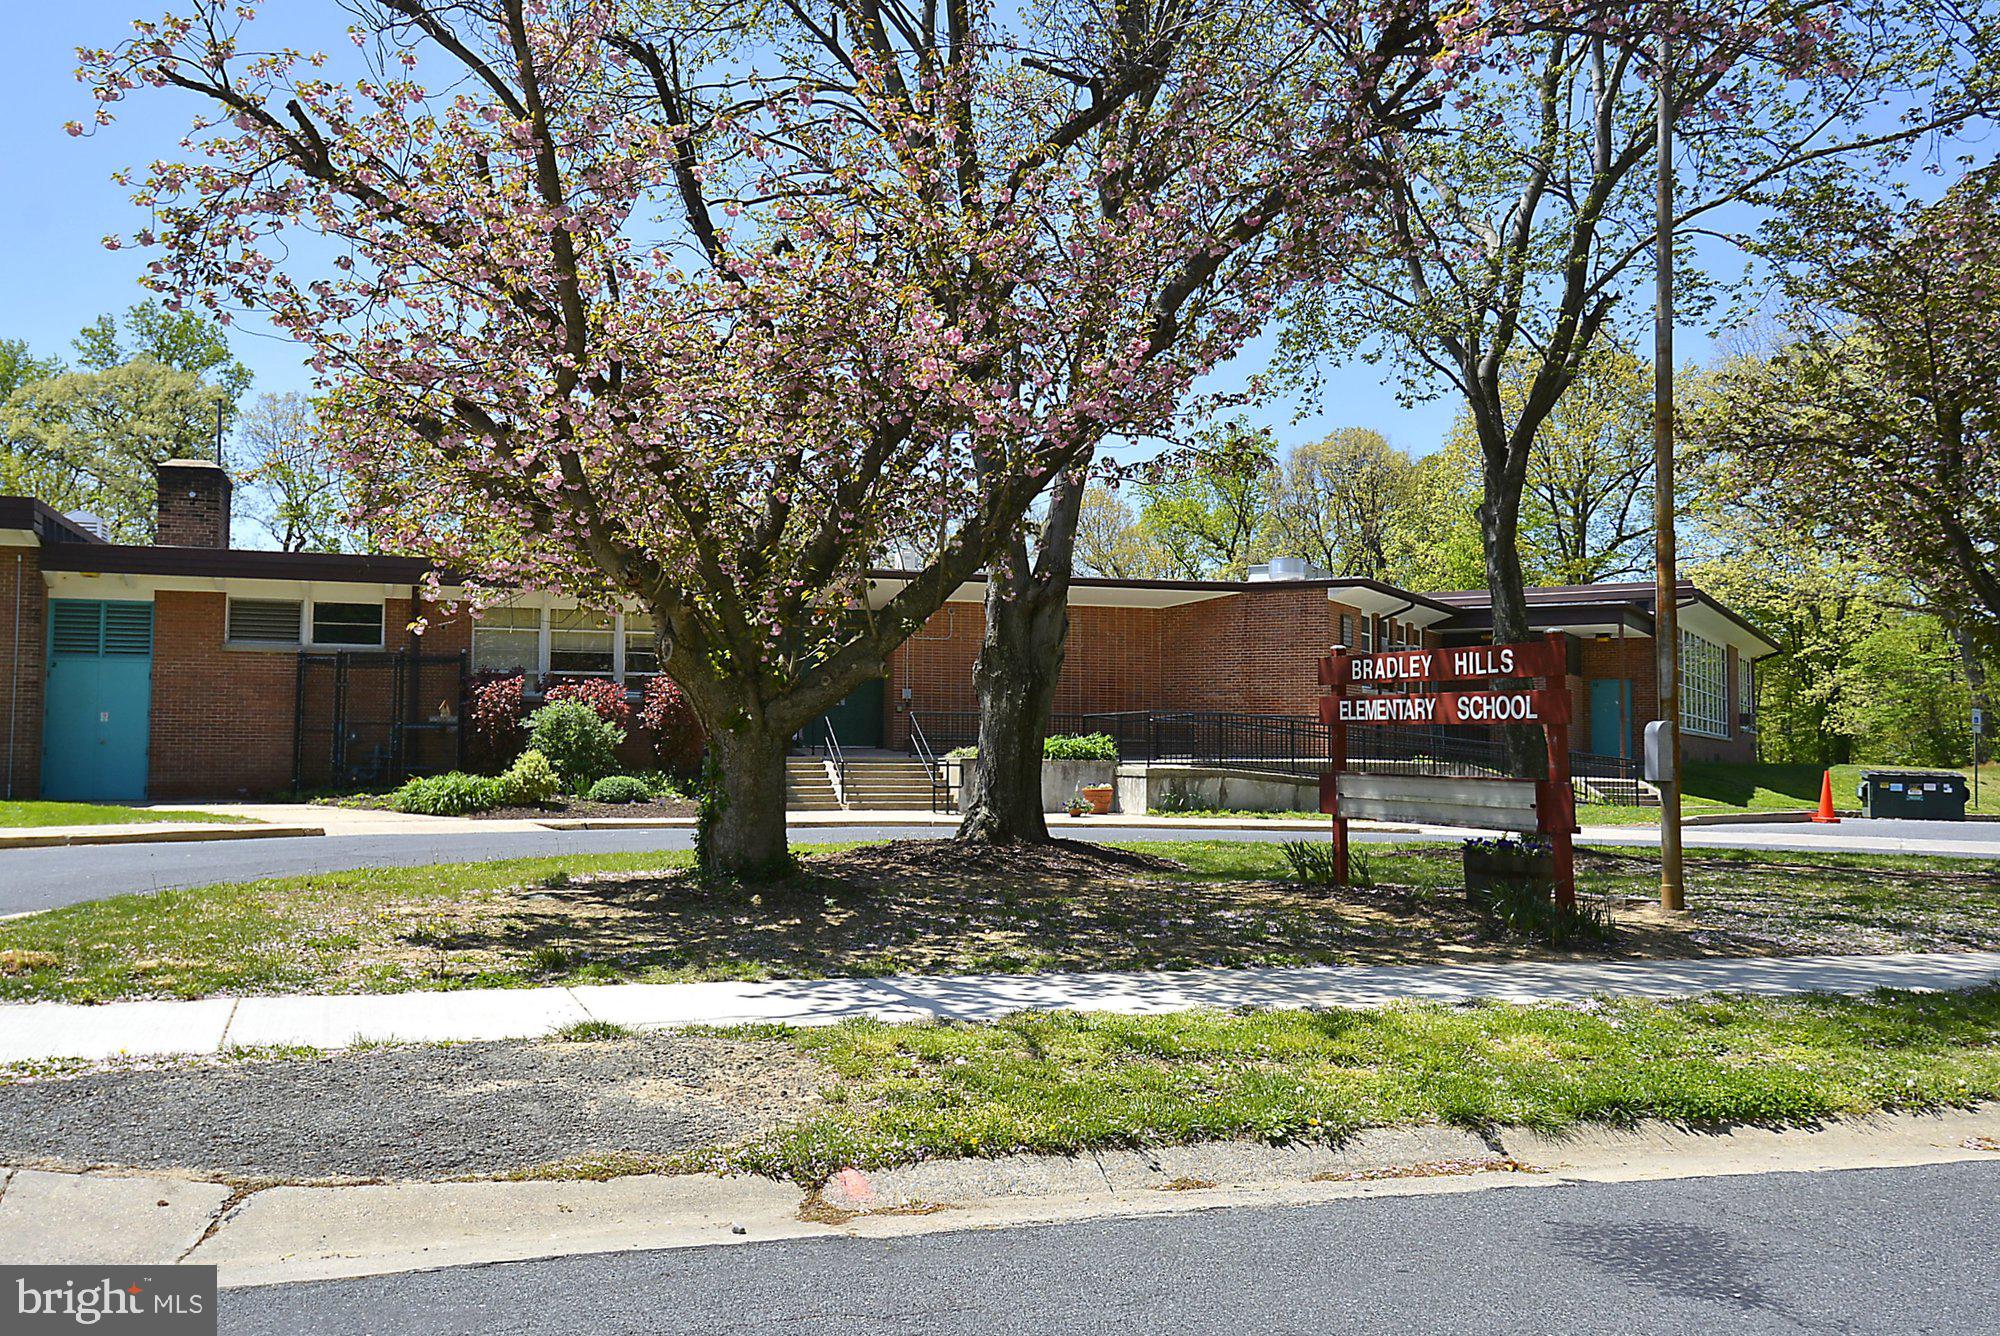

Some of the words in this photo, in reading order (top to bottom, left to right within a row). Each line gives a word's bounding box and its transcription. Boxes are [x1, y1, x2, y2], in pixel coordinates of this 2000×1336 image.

[1351, 655, 1433, 680] BRADLEY
[1454, 649, 1514, 675] HILLS
[1339, 697, 1436, 721] ELEMENTARY
[1457, 695, 1538, 721] SCHOOL
